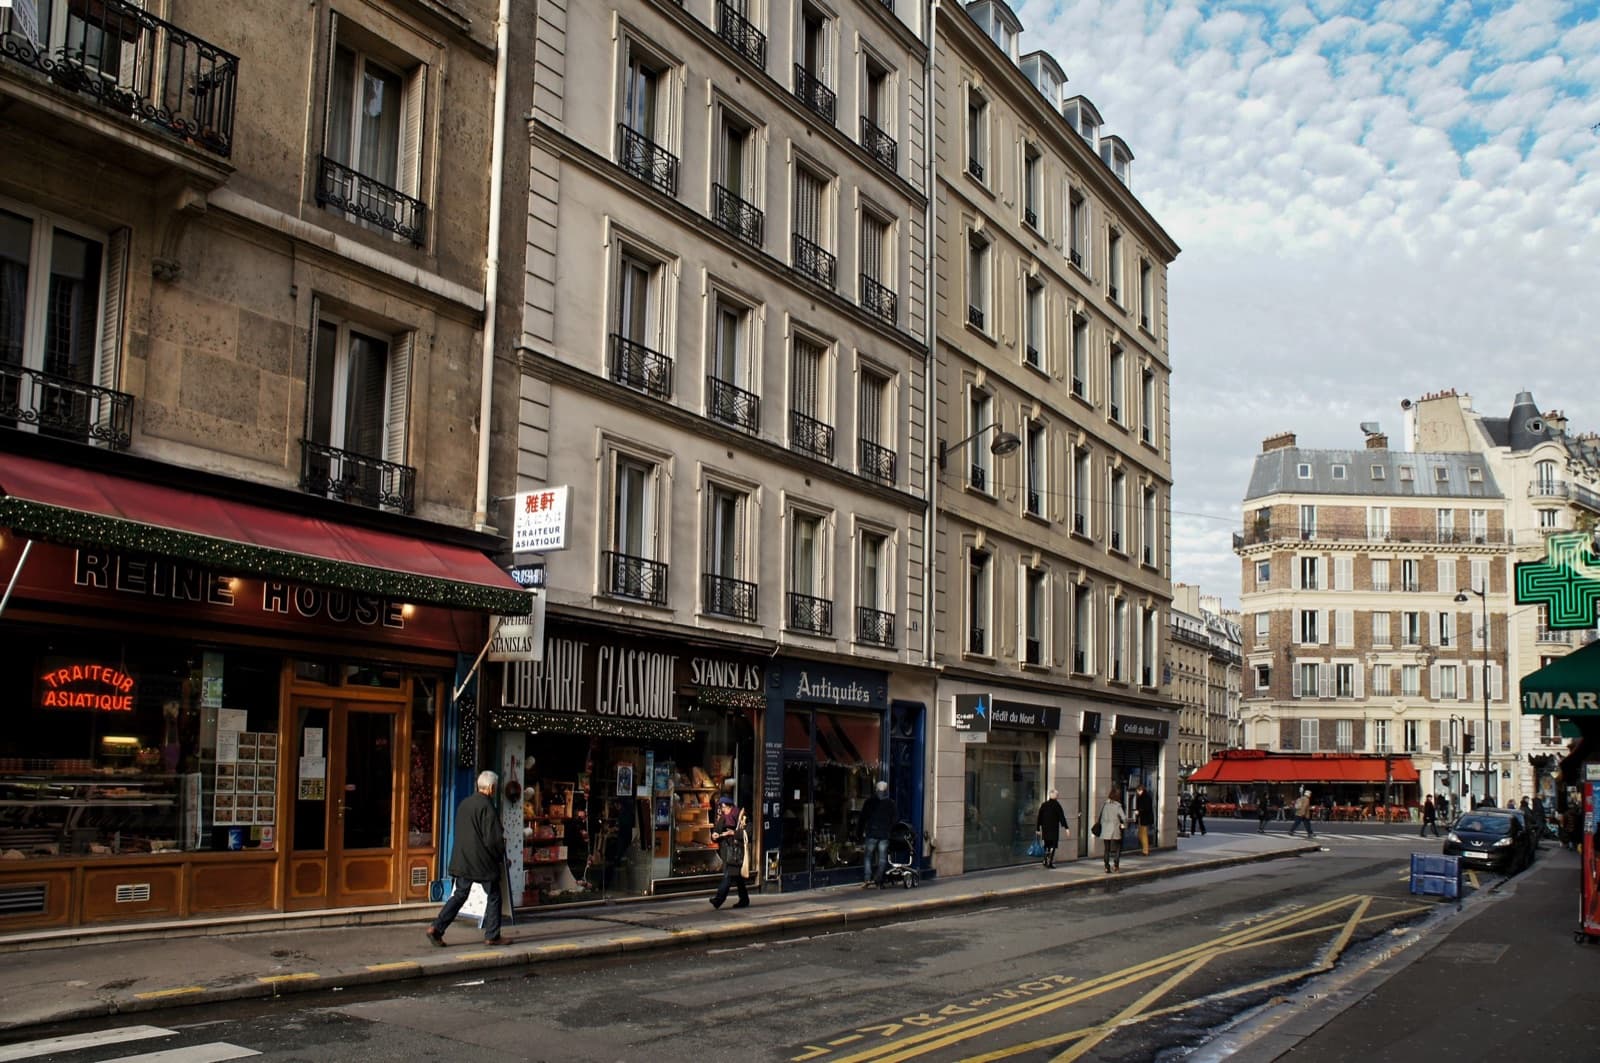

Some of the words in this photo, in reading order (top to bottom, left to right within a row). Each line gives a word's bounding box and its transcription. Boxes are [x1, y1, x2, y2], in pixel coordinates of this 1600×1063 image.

[525, 492, 555, 514] 雅軒
[517, 526, 561, 538] TRAITEUR
[515, 536, 561, 548] ASIATIQUE
[511, 569, 543, 584] SUSHI
[74, 549, 235, 606] REINE
[262, 580, 405, 629] HOUSE
[491, 636, 533, 653] STANISLAS
[42, 664, 134, 693] TRAITEUR
[501, 637, 590, 713] LIBRAIRIE
[596, 644, 680, 721] CLASSIQUE
[690, 656, 760, 691] STANISLAS
[796, 671, 870, 704] Antiquités
[44, 690, 134, 711] ASIATIQUE
[1526, 691, 1600, 709] MAR
[991, 710, 1009, 722] rédit
[1009, 711, 1019, 723] du
[1019, 712, 1035, 725] Nord
